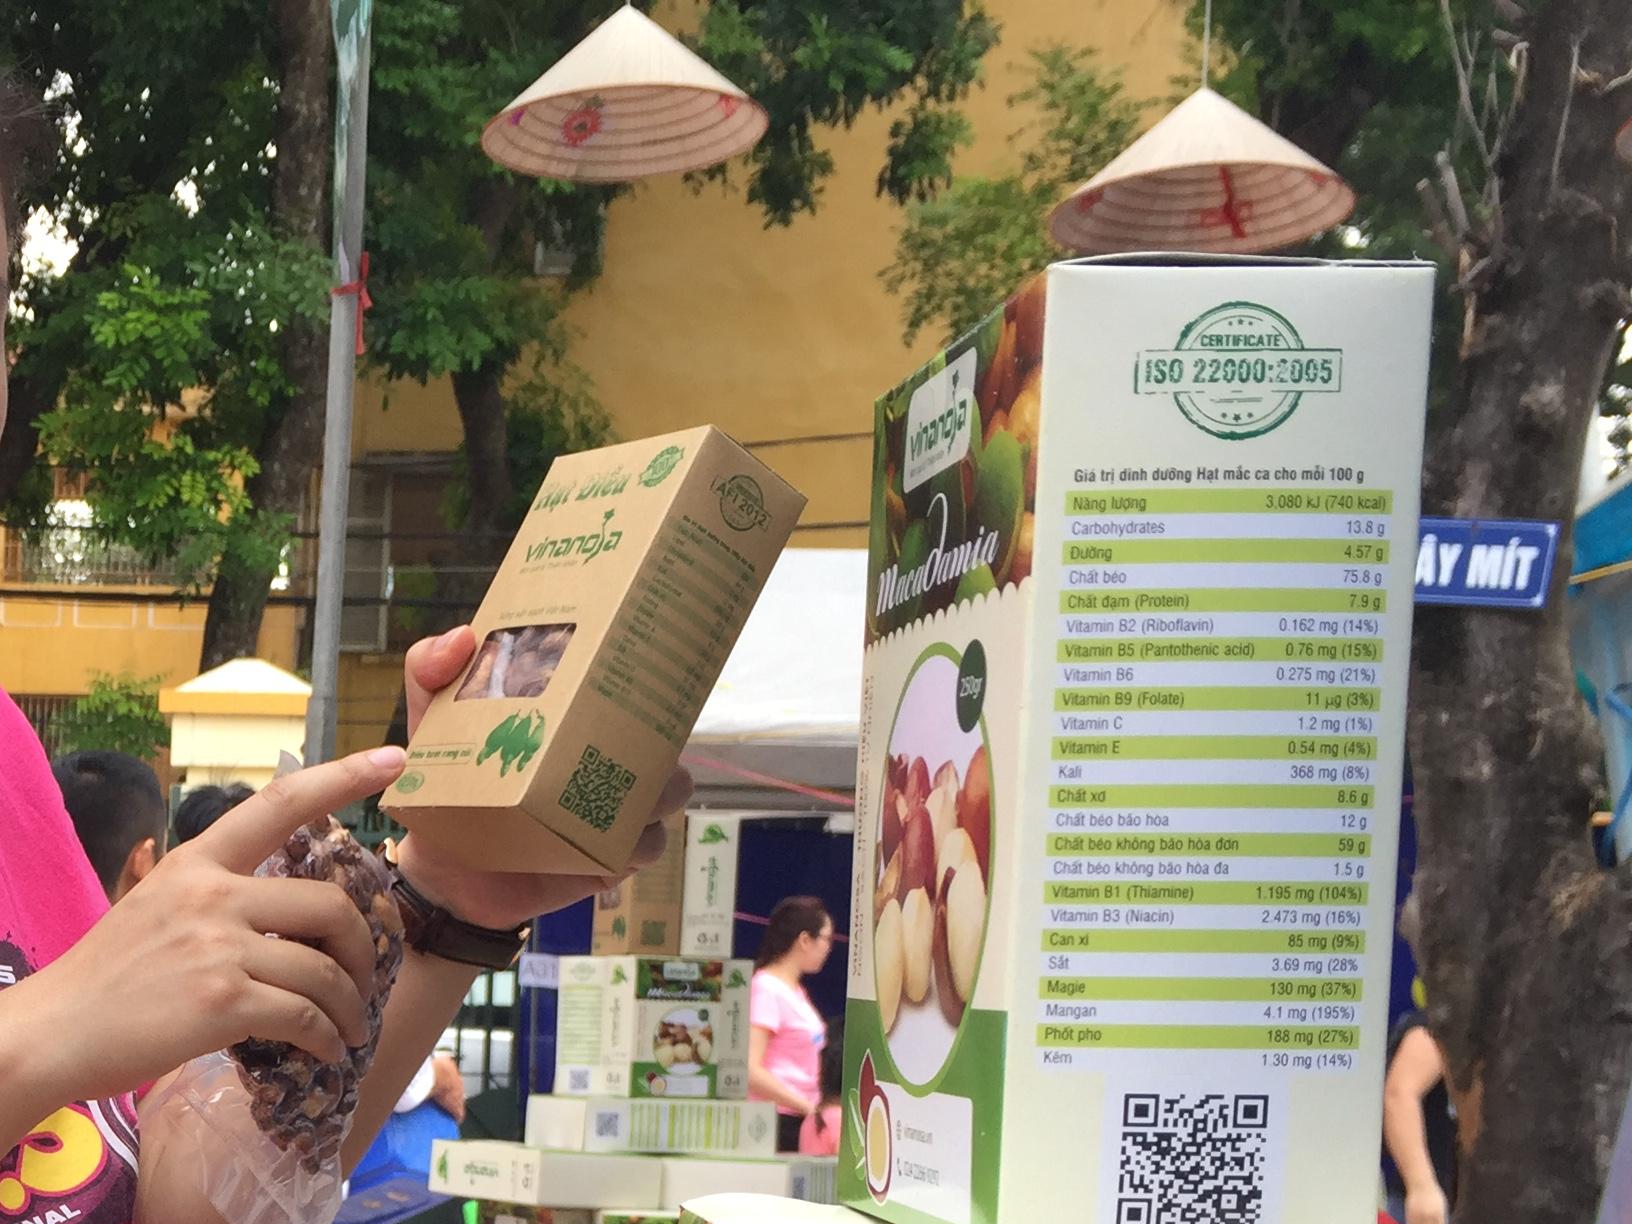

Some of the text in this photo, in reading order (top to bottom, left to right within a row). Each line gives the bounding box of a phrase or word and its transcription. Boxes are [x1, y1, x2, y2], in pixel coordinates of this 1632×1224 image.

[1201, 334, 1282, 347] CERTIFICATE
[1144, 358, 1333, 384] ISO 22000:2005
[1119, 467, 1147, 482] dinh
[1254, 469, 1270, 481] ca
[1274, 466, 1297, 481] cho
[1329, 467, 1353, 482] 100
[1356, 470, 1365, 485] g
[1306, 495, 1321, 509] kJ
[1324, 495, 1354, 512] (740
[1357, 495, 1386, 512] kcal)
[1071, 519, 1385, 538] Carbohydrates 13.8 g
[1343, 544, 1373, 559] 4.57
[1375, 547, 1384, 562] g
[1465, 536, 1541, 591] MÍT
[1066, 617, 1379, 636] Vitamin B2 (Riboflavin) 0.162 mg (14%)
[1059, 740, 1371, 758] Vitamin E 0.54 mg (4%)
[1058, 764, 1370, 783] Kali 368 mg (8%)
[1050, 908, 1361, 927] Vitamin B3 (Niacin) 2.473 mg (16%)
[1045, 1003, 1355, 1023] Mangan 4.1 mg (195%)
